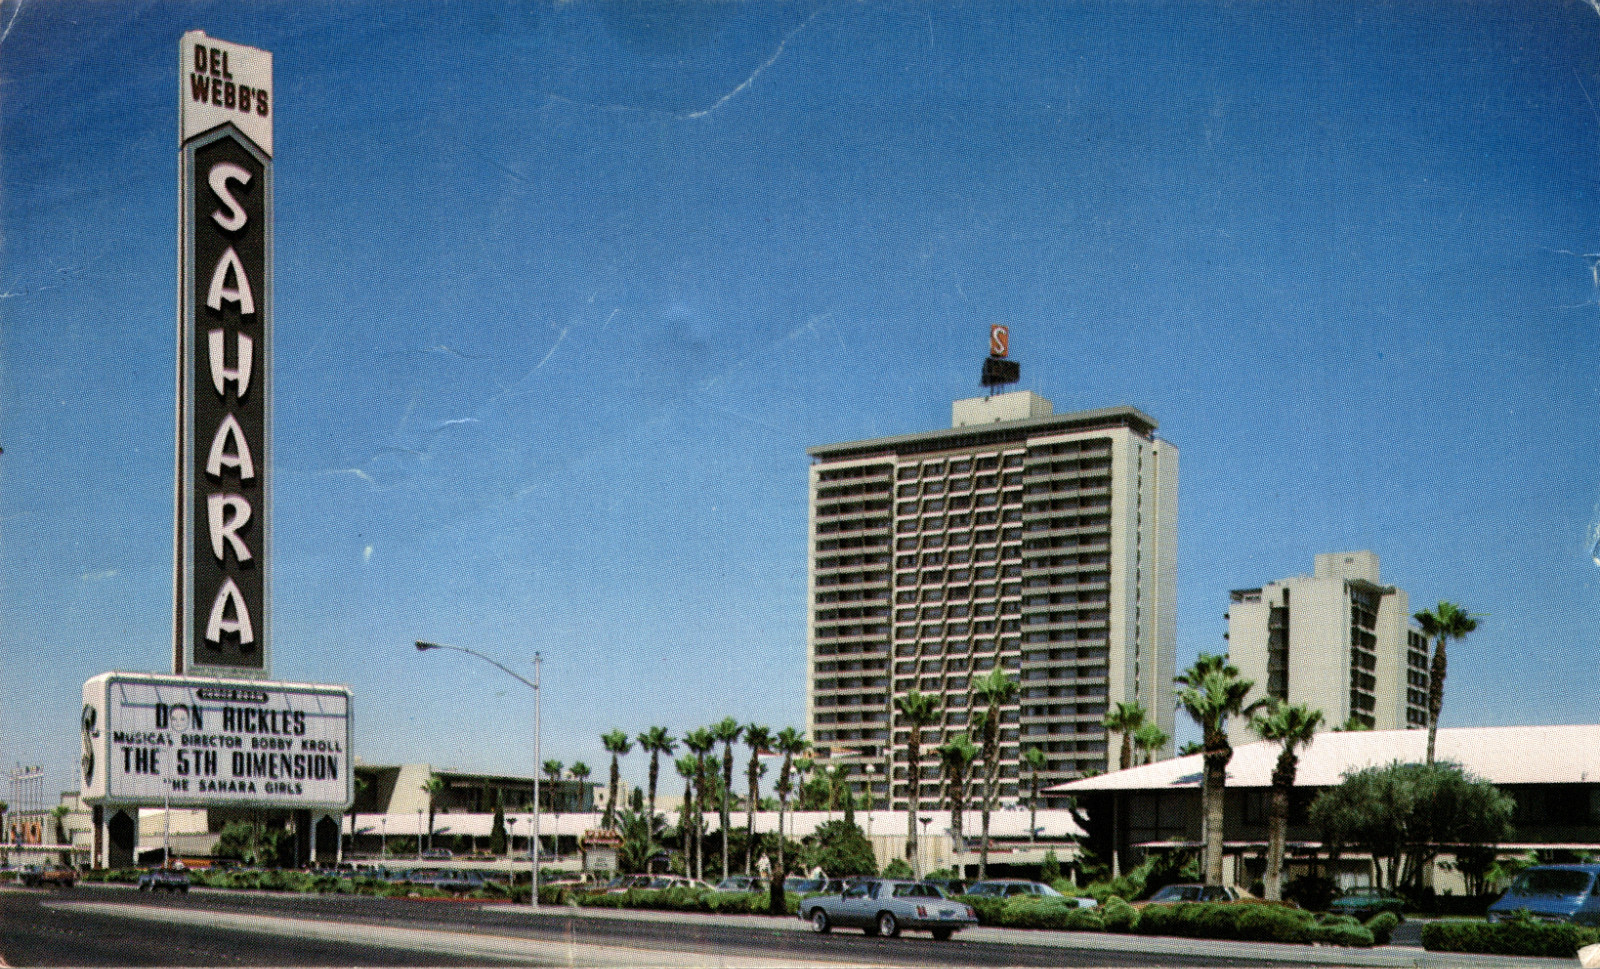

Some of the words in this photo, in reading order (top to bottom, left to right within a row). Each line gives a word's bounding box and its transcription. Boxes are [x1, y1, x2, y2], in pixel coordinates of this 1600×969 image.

[194, 44, 233, 80] DEL
[190, 72, 269, 117] WEBB'S
[992, 327, 1007, 354] S
[206, 161, 255, 645] SAHARA
[223, 706, 305, 736] RICKLES
[181, 734, 242, 749] DIRECTOR
[251, 737, 293, 750] BOBBY
[301, 740, 342, 753] KROLL
[121, 746, 159, 775] THE
[177, 748, 217, 776] 5TH
[232, 751, 338, 780] DIMENSION
[199, 779, 257, 793] SAHARA
[265, 781, 302, 795] GIRLS
